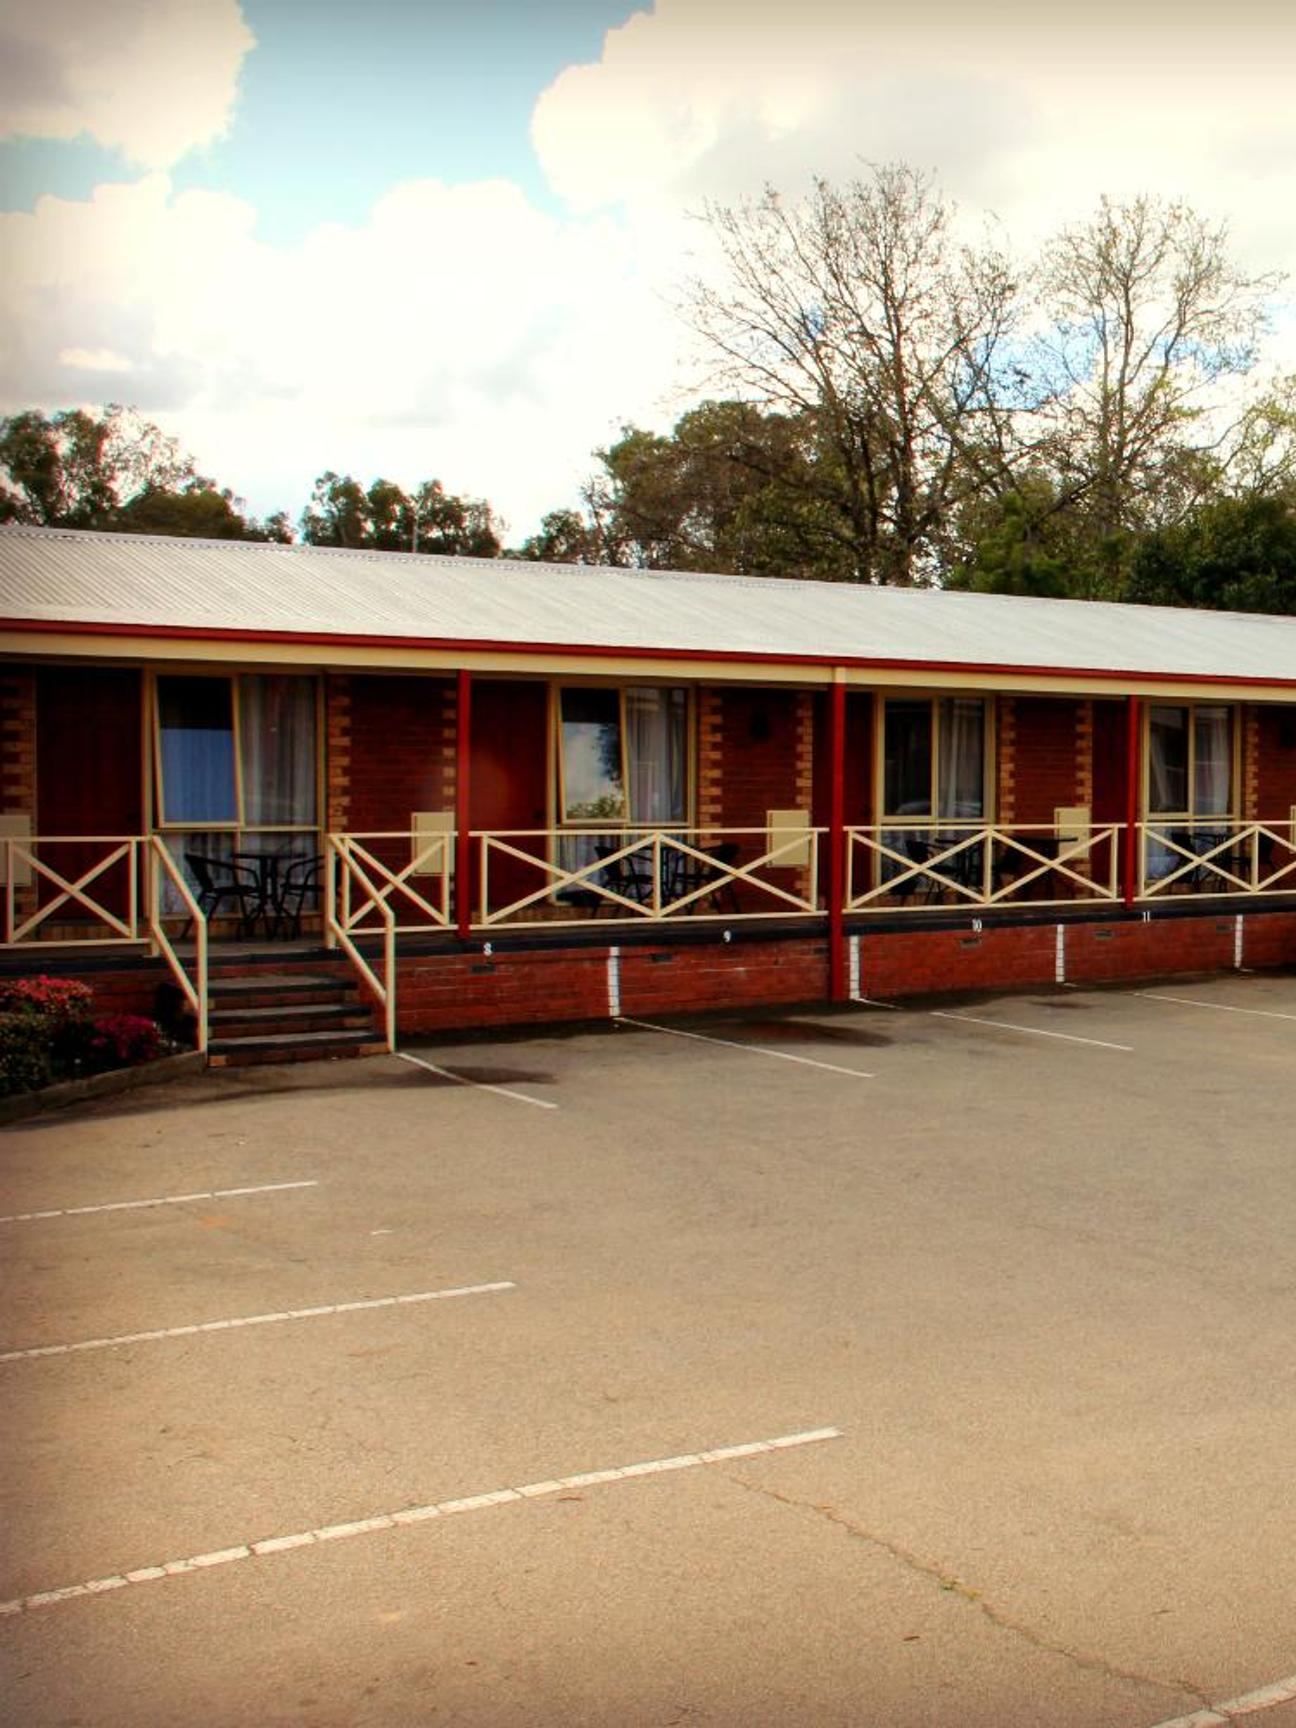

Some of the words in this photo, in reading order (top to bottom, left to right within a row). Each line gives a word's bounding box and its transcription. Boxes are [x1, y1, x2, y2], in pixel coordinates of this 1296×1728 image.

[1142, 911, 1151, 922] 11
[972, 919, 983, 932] 10
[723, 930, 731, 942] 9
[483, 942, 493, 956] 8
